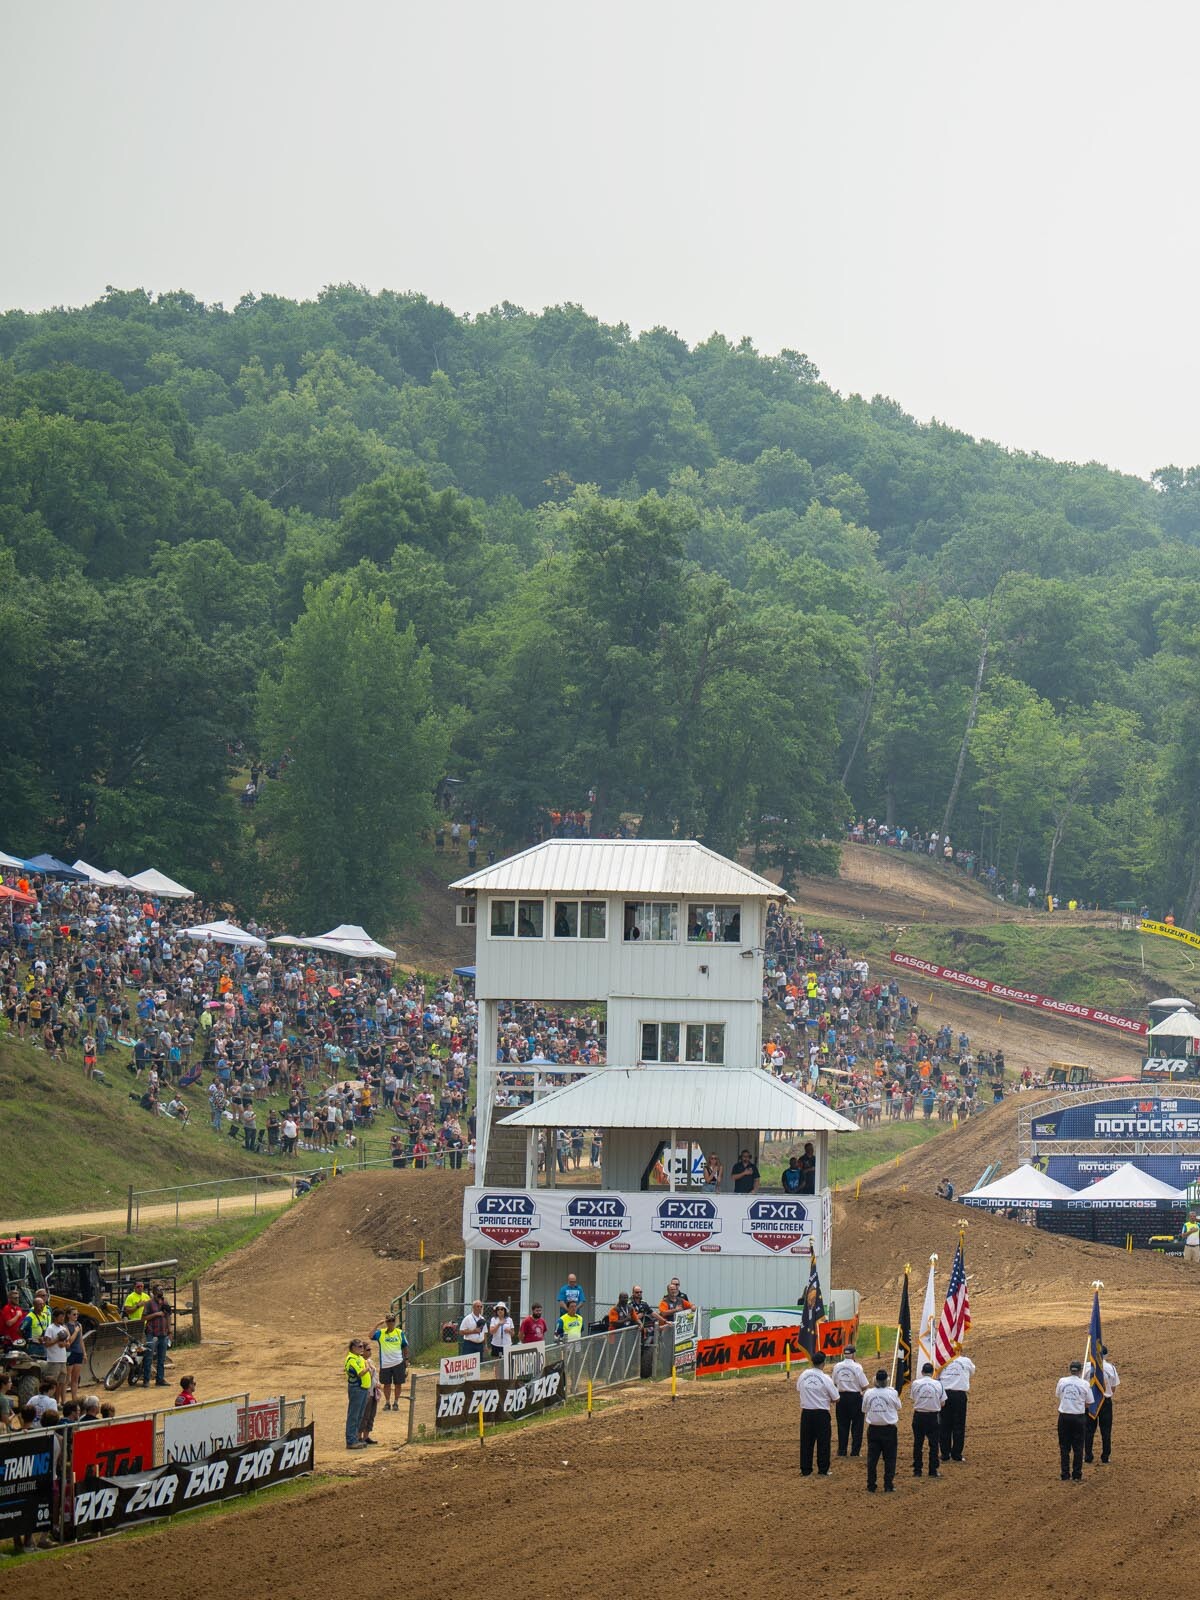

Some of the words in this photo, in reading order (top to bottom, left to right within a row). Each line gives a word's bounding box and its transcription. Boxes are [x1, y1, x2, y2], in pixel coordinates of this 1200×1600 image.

[1159, 926, 1188, 939] SUZUKI
[894, 954, 938, 973] GASGAS
[942, 969, 987, 989] GASGAS
[991, 984, 1038, 1002] GASGAS
[1042, 998, 1089, 1016] GASGAS
[1093, 1011, 1141, 1031] GASGAS
[1143, 1058, 1189, 1072] FXR
[486, 1198, 526, 1212] FXR
[577, 1201, 616, 1215] FXR
[668, 1202, 707, 1216] FXR
[964, 1198, 1053, 1208] PROMOTOCROSS
[1067, 1200, 1157, 1209] PROMOTOCROSS
[758, 1204, 798, 1218] FXR
[478, 1216, 506, 1225] SPRING
[508, 1217, 532, 1226] CREEK
[569, 1219, 597, 1228] SPRING
[598, 1220, 623, 1228] CREEK
[659, 1220, 687, 1229] SPRING
[689, 1221, 713, 1230] CREEK
[750, 1222, 778, 1231] SPRING
[780, 1223, 804, 1232] CREEK
[696, 1343, 731, 1368] KTM
[737, 1337, 775, 1360] KTM
[438, 1391, 466, 1418] FXR
[468, 1389, 499, 1414] FXR
[504, 1387, 527, 1412] FXR
[531, 1371, 560, 1404] FXR
[75, 1487, 119, 1526] FXR
[125, 1474, 179, 1513] FXR
[184, 1459, 229, 1499] FXR
[235, 1447, 275, 1485] FXR
[279, 1434, 313, 1470] FXR
